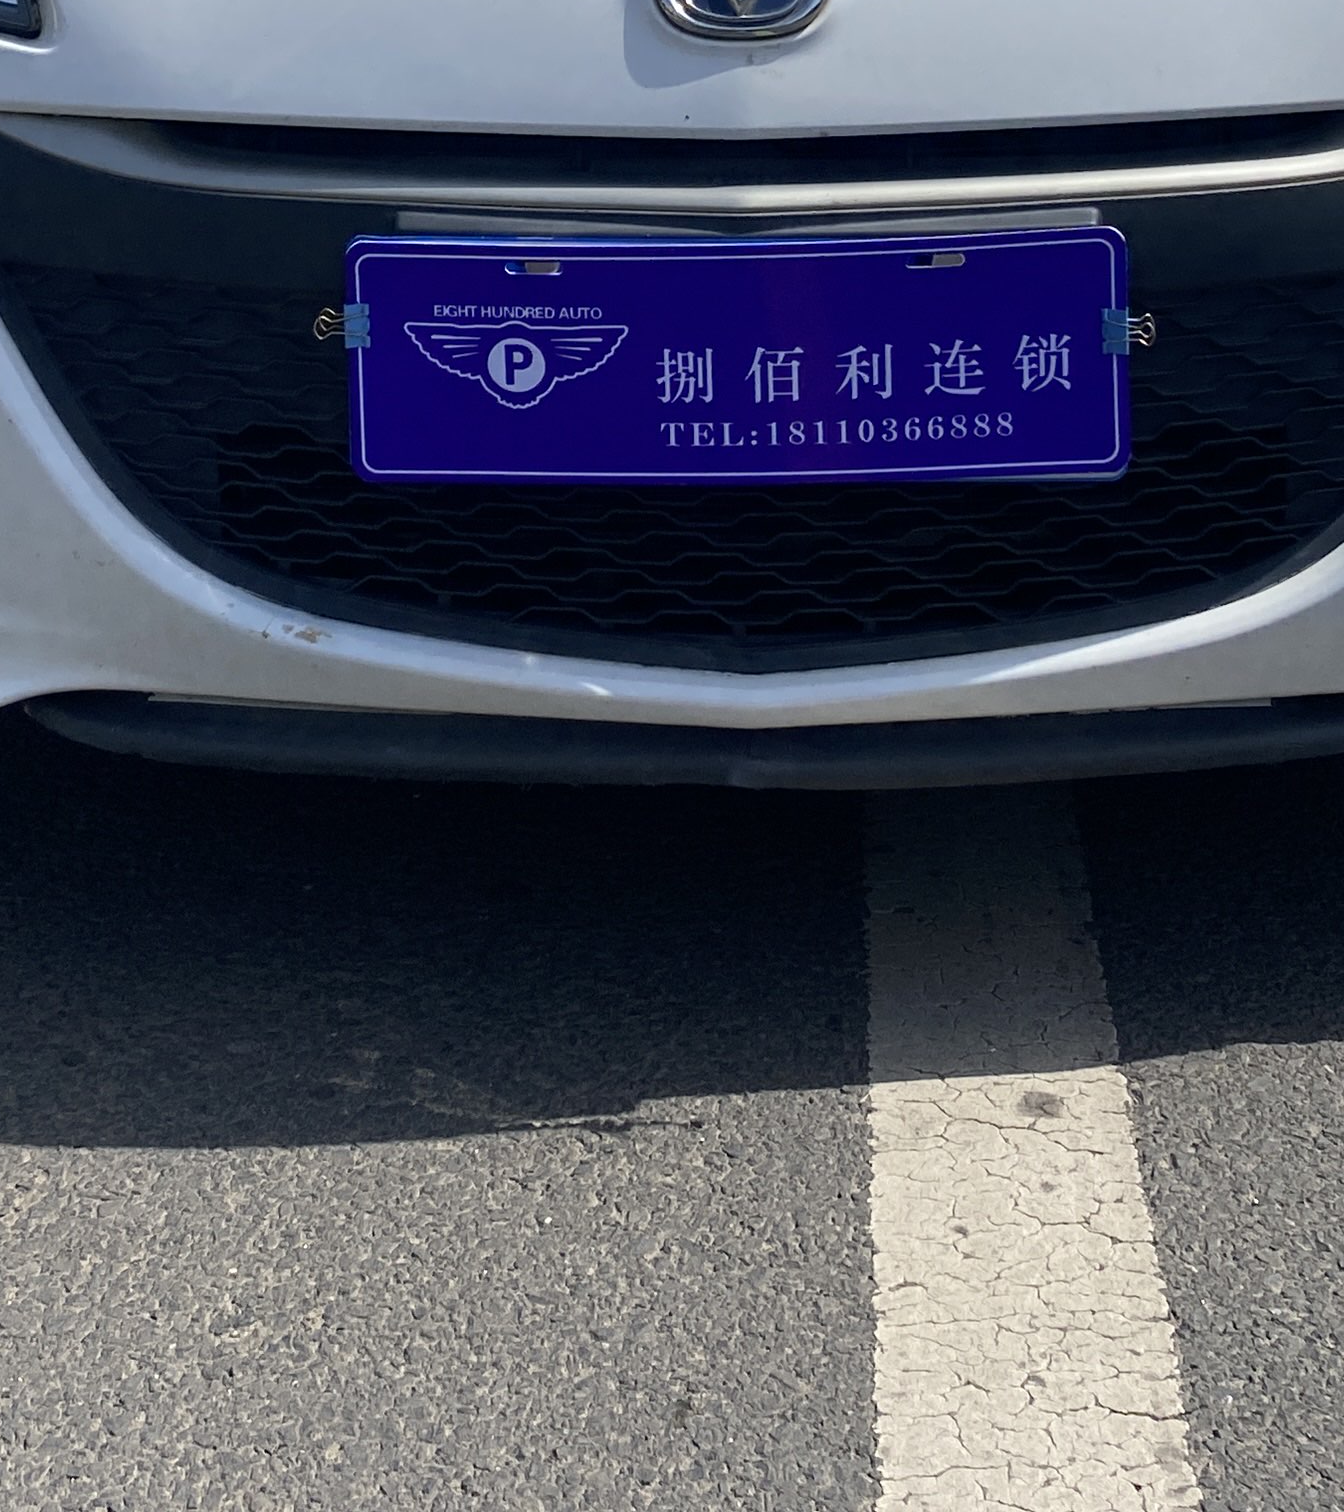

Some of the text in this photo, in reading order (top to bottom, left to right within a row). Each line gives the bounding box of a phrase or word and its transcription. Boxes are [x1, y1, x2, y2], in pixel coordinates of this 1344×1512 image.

[432, 304, 603, 320] EIGHT HUNDRED AUTO
[503, 343, 534, 386] P
[656, 333, 1072, 404] 捌佰利连锁
[660, 411, 1014, 447] TEL:18110366888
